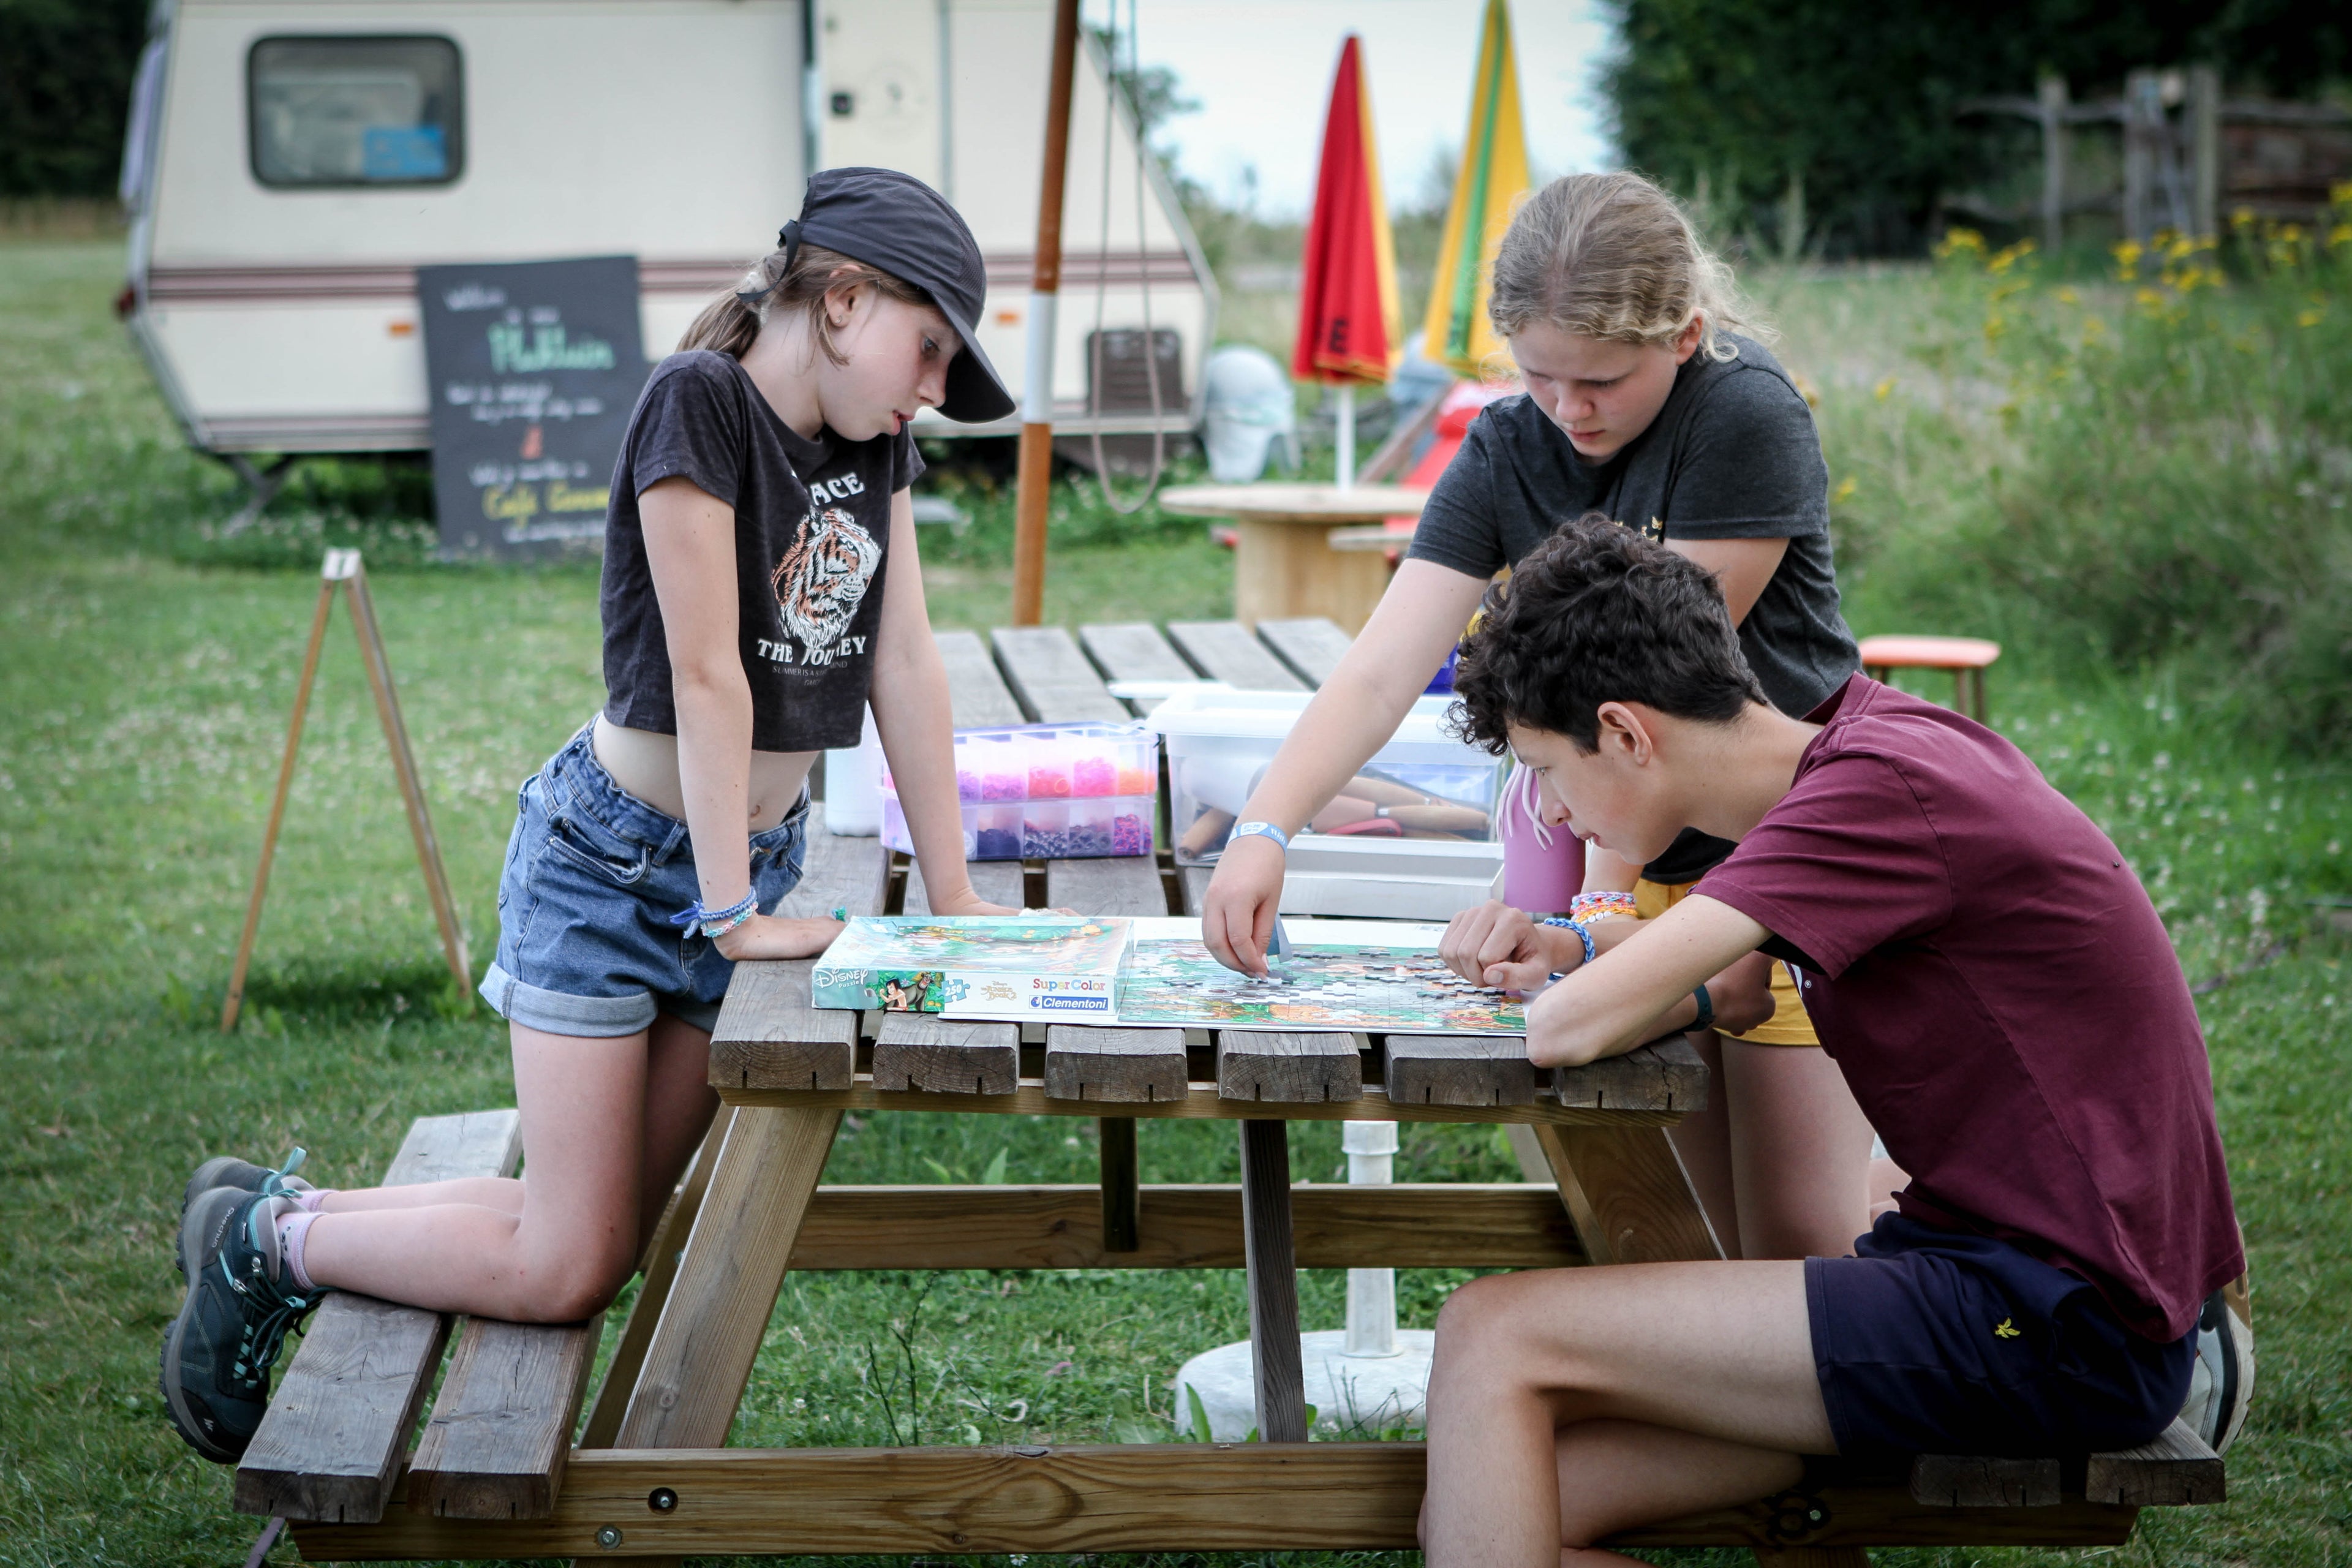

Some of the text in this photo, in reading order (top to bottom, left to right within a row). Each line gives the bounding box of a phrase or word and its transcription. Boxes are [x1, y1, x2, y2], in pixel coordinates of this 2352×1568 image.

[791, 469, 865, 506] ACE
[757, 638, 793, 663] THE
[945, 984, 962, 997] 250
[1043, 997, 1107, 1009] Clementoni
